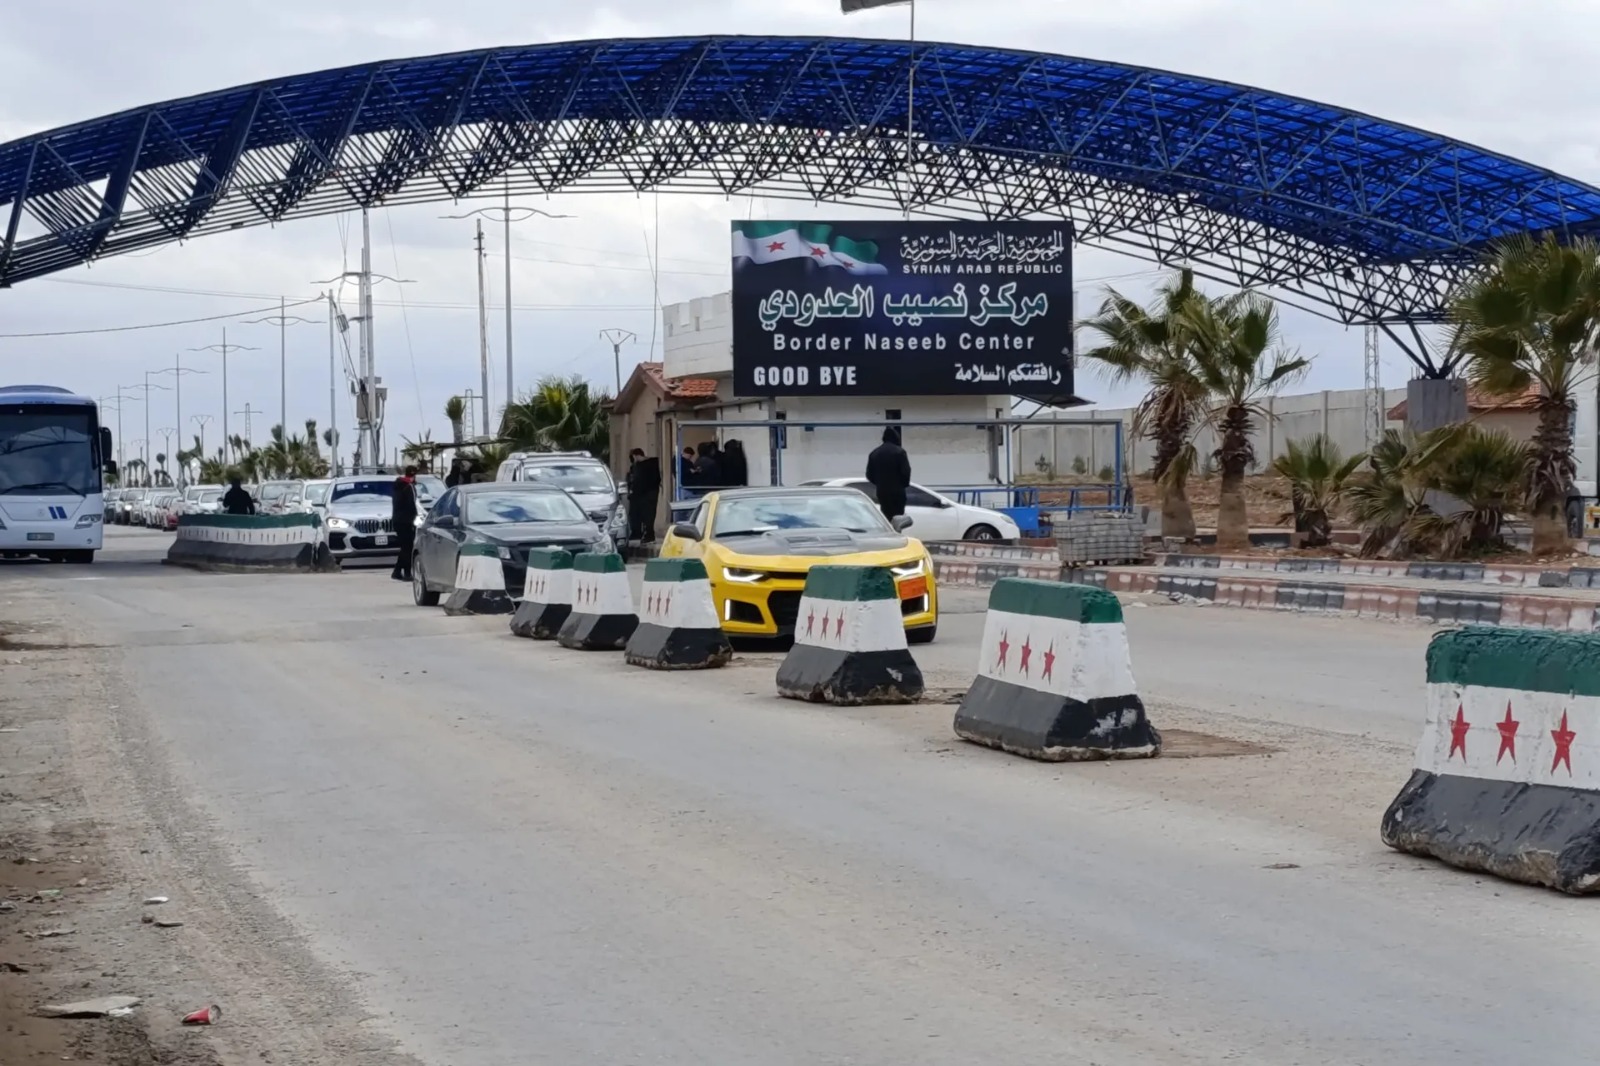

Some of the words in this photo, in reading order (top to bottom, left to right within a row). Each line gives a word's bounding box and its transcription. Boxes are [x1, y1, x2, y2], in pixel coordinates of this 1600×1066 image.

[903, 264, 951, 274] SYRIAN
[957, 264, 992, 274] ARAB
[998, 264, 1063, 274] REPUBLIC
[758, 283, 875, 331] الحدودي
[883, 282, 968, 326] نصيب
[969, 282, 1048, 326] مركز
[773, 333, 852, 350] Border
[864, 332, 947, 350] Naseeb
[959, 333, 1035, 350] Center
[753, 366, 809, 386] GOOD
[819, 366, 857, 386] BYE
[954, 363, 1005, 382] السلامة
[1007, 362, 1062, 386] رافقتكم
